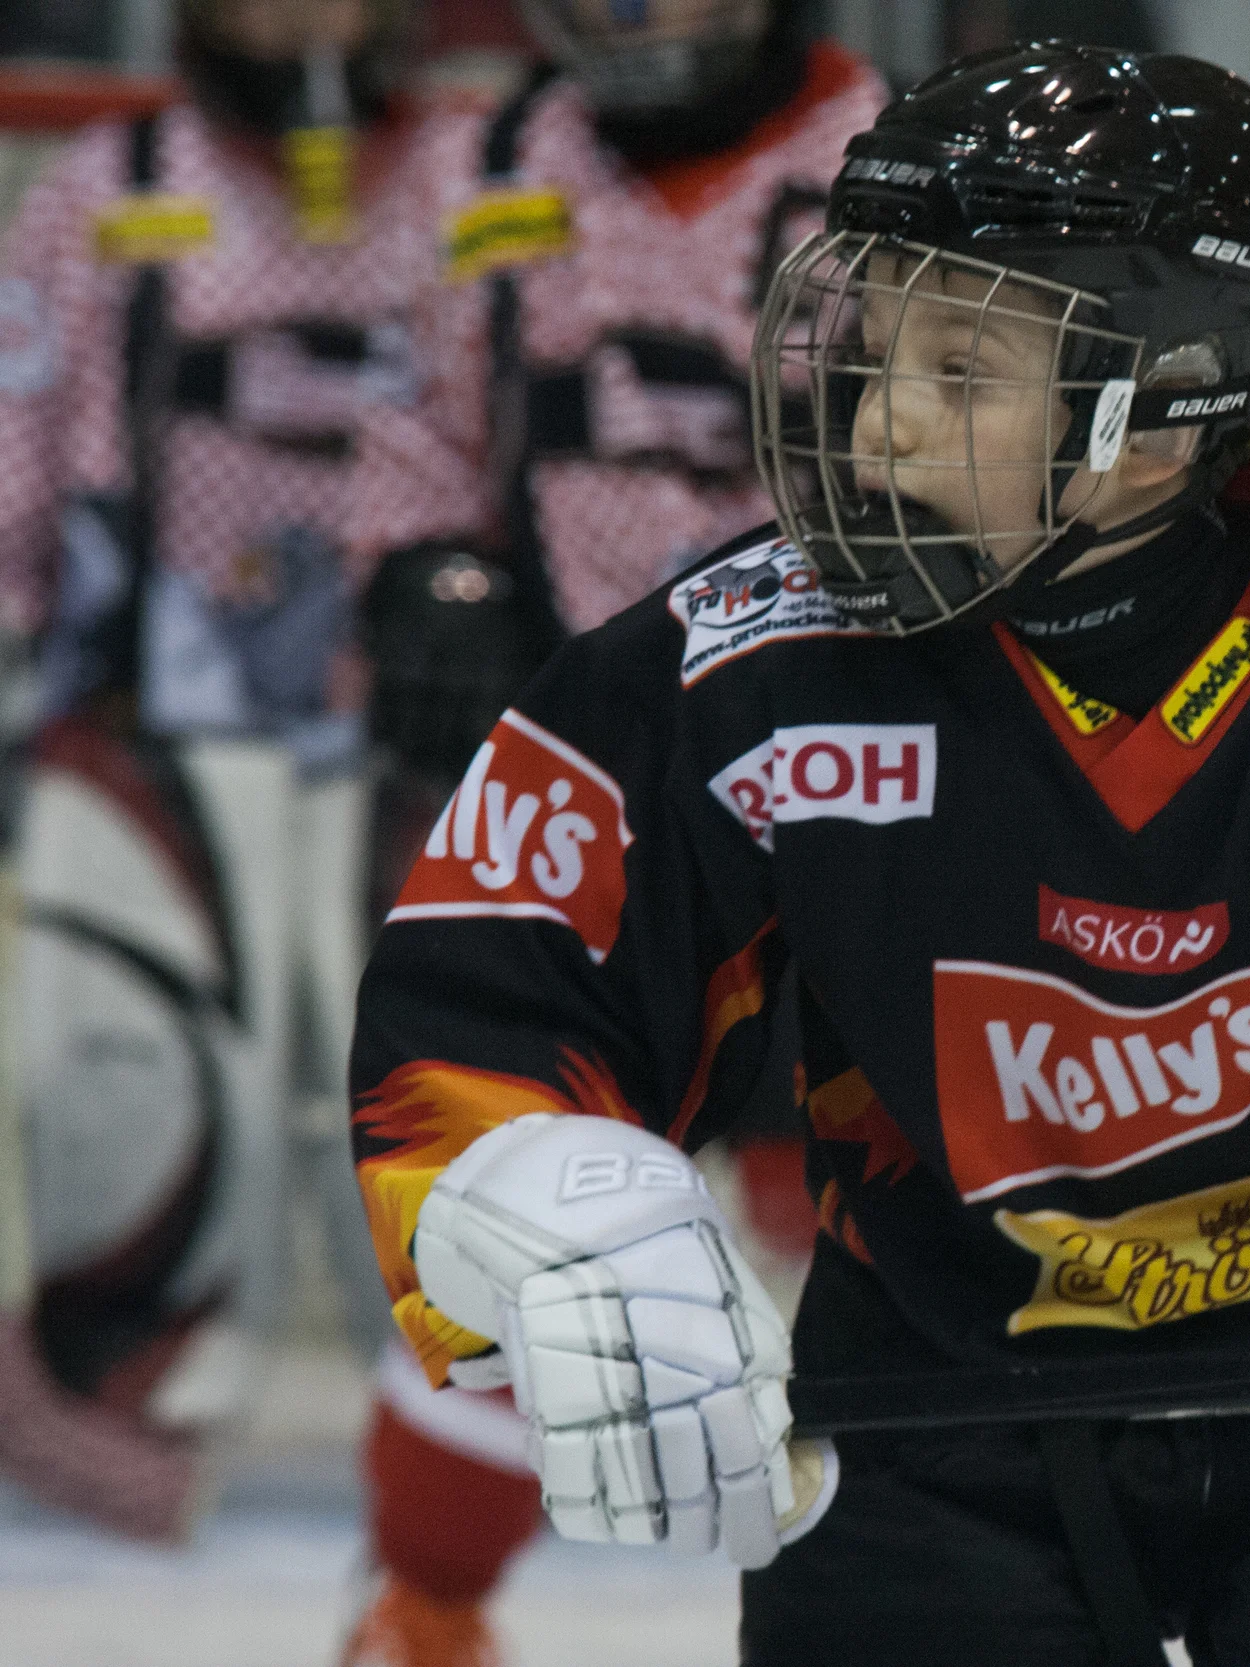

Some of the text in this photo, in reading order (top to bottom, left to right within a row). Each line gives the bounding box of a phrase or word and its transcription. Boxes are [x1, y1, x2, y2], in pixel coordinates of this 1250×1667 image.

[1166, 391, 1248, 419] BAUER
[424, 740, 597, 899] lly's
[1051, 906, 1165, 964] ASKÖ
